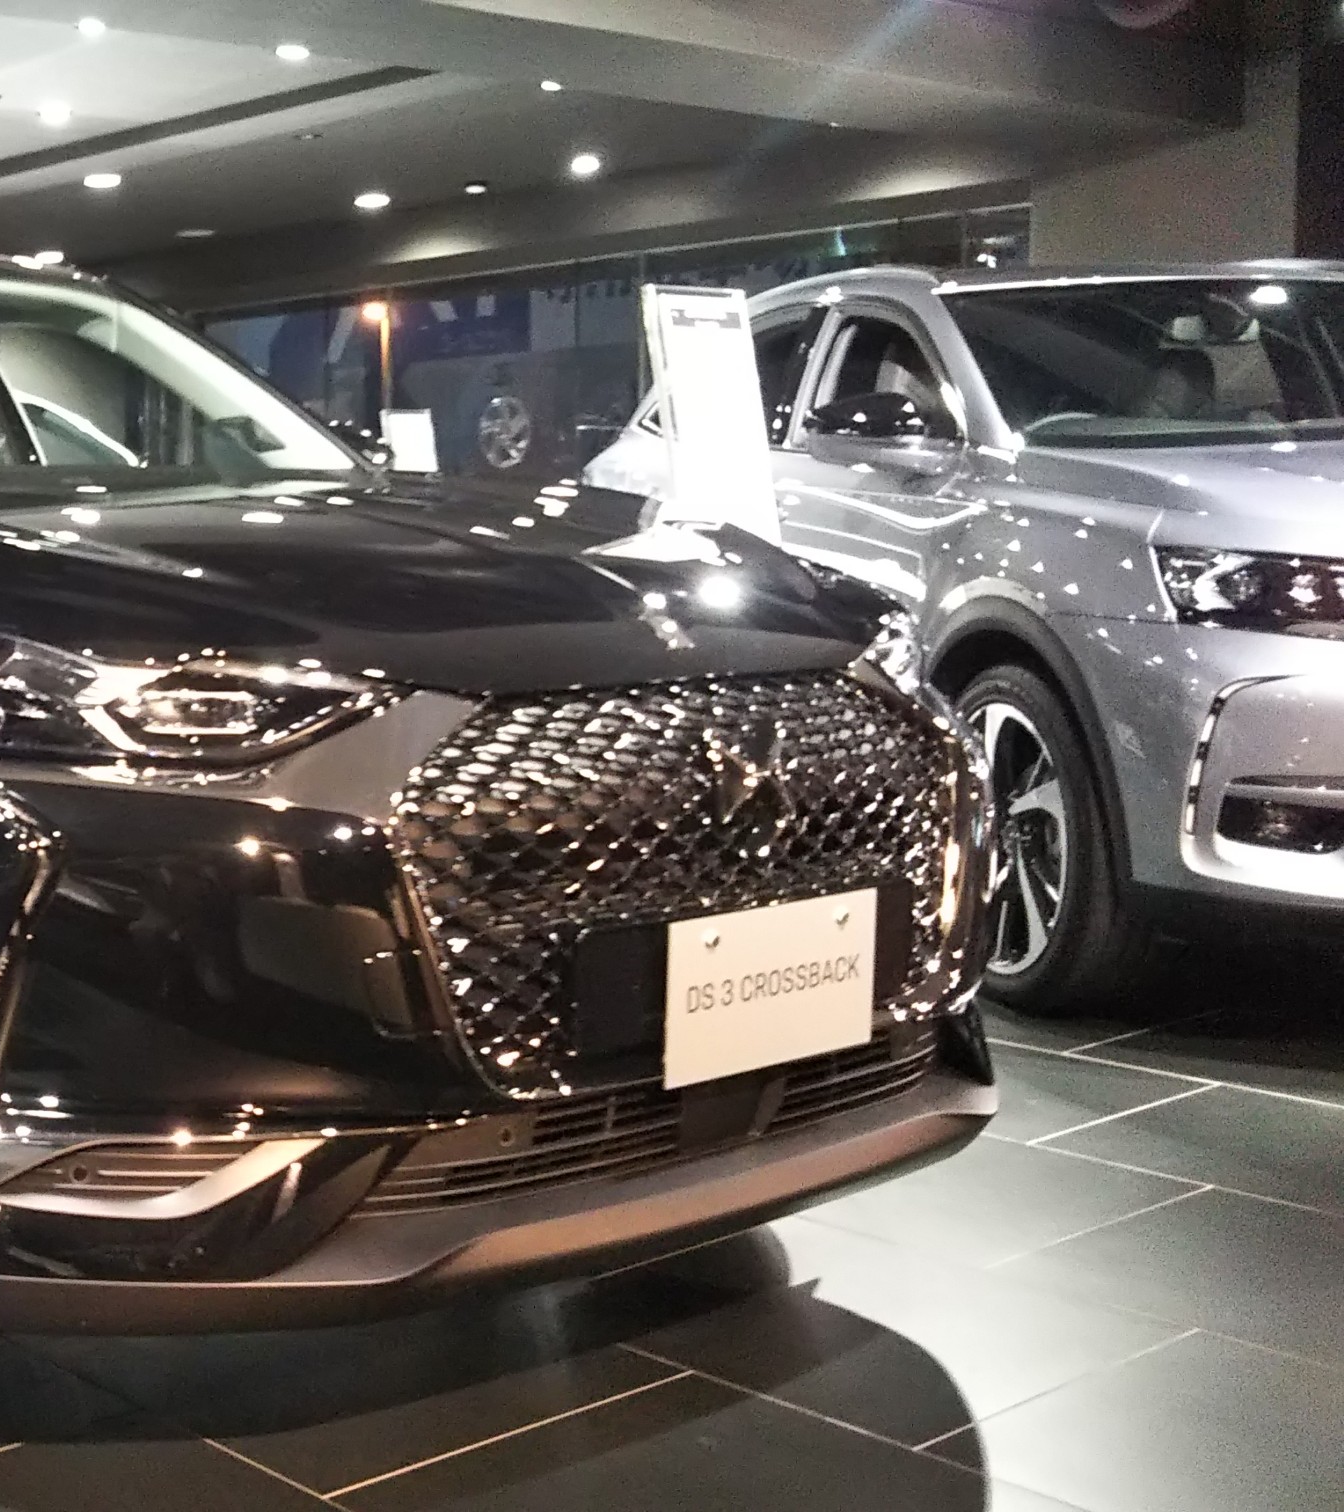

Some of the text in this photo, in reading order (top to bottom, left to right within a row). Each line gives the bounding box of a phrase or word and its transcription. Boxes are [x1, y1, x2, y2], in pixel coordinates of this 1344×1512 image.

[687, 954, 860, 1013] DS 3 CROSSBACK
